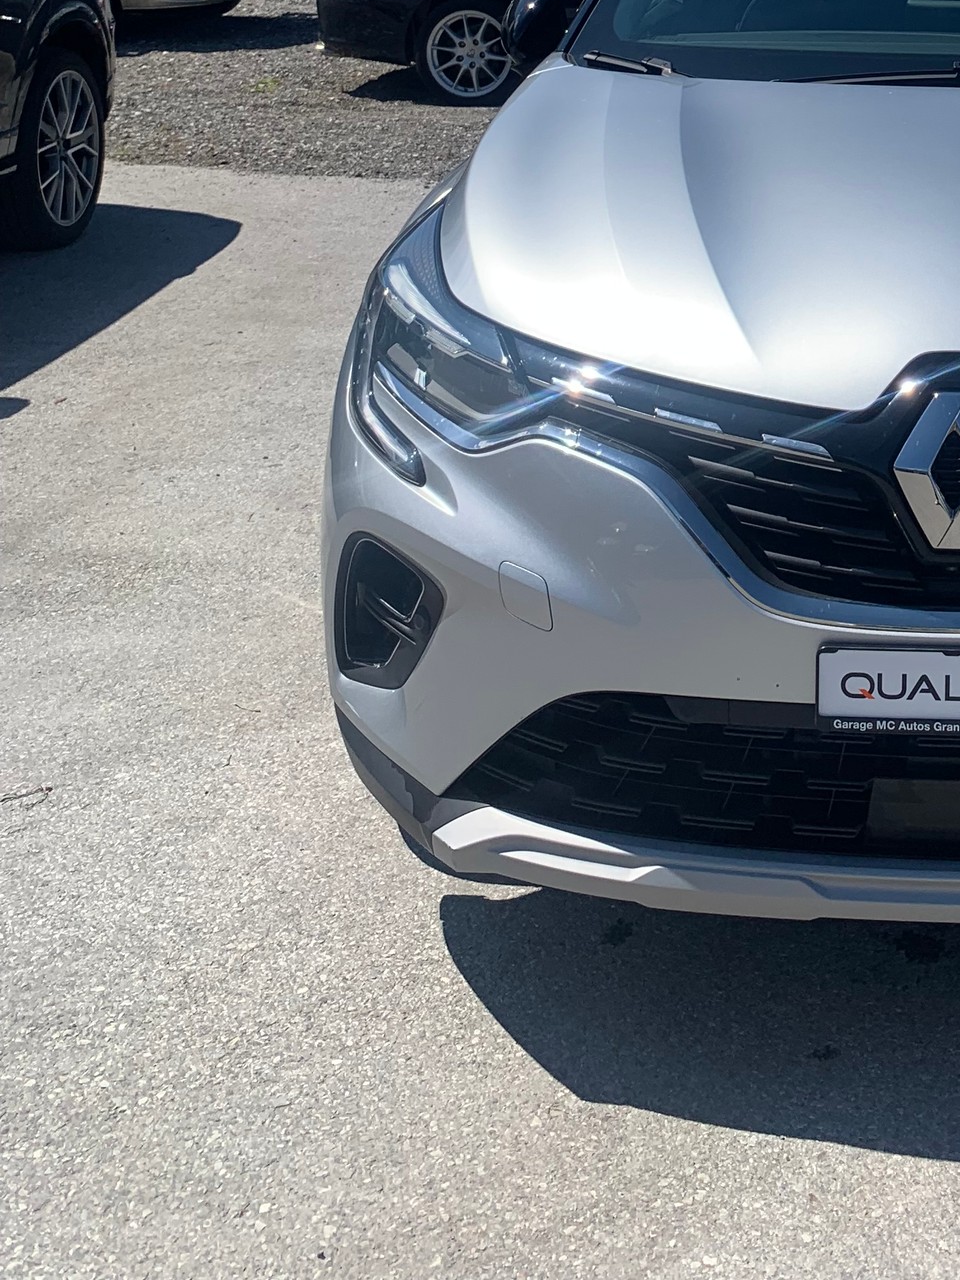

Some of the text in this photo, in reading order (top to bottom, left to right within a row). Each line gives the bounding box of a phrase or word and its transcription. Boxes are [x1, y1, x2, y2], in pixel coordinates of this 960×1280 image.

[833, 719, 873, 732] Garage
[876, 720, 896, 731] MC
[898, 721, 931, 732] Autos
